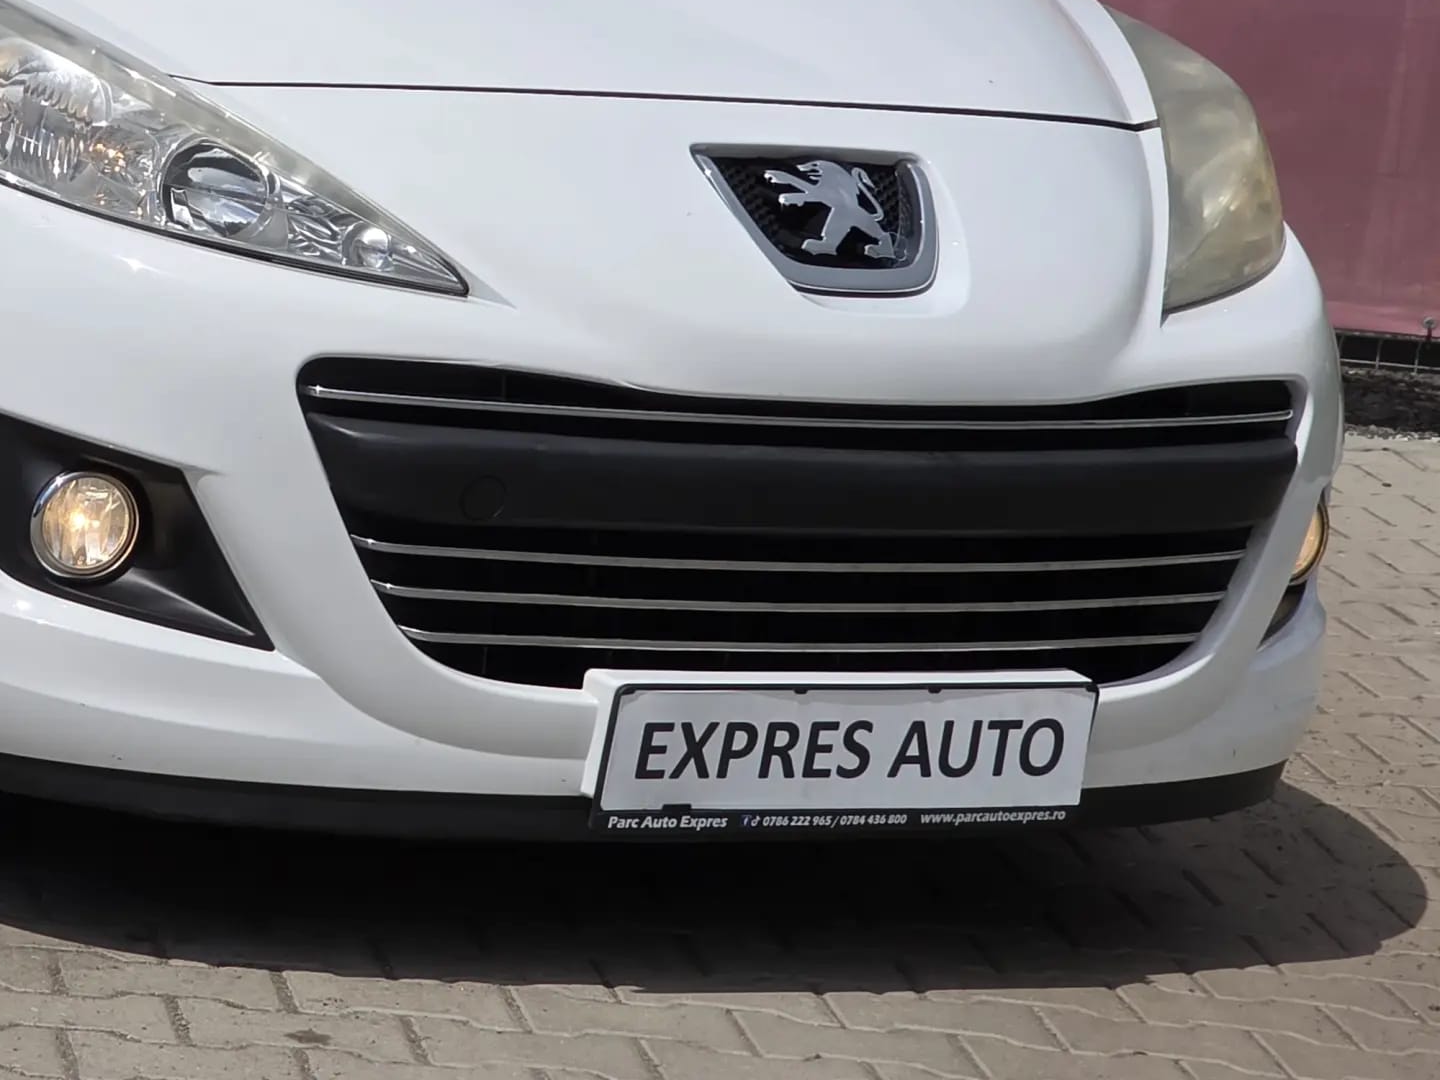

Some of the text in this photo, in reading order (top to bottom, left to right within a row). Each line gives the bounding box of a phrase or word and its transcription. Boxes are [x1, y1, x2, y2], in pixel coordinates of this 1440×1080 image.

[634, 718, 1065, 780] EXPRES AUTO
[607, 816, 640, 829] Parc
[640, 816, 678, 829] Auto
[679, 815, 729, 831] Expres
[762, 815, 790, 827] 0786
[789, 815, 812, 827] 222
[812, 815, 833, 827] 965
[920, 810, 1067, 826] www.parcautoexpres.ro
